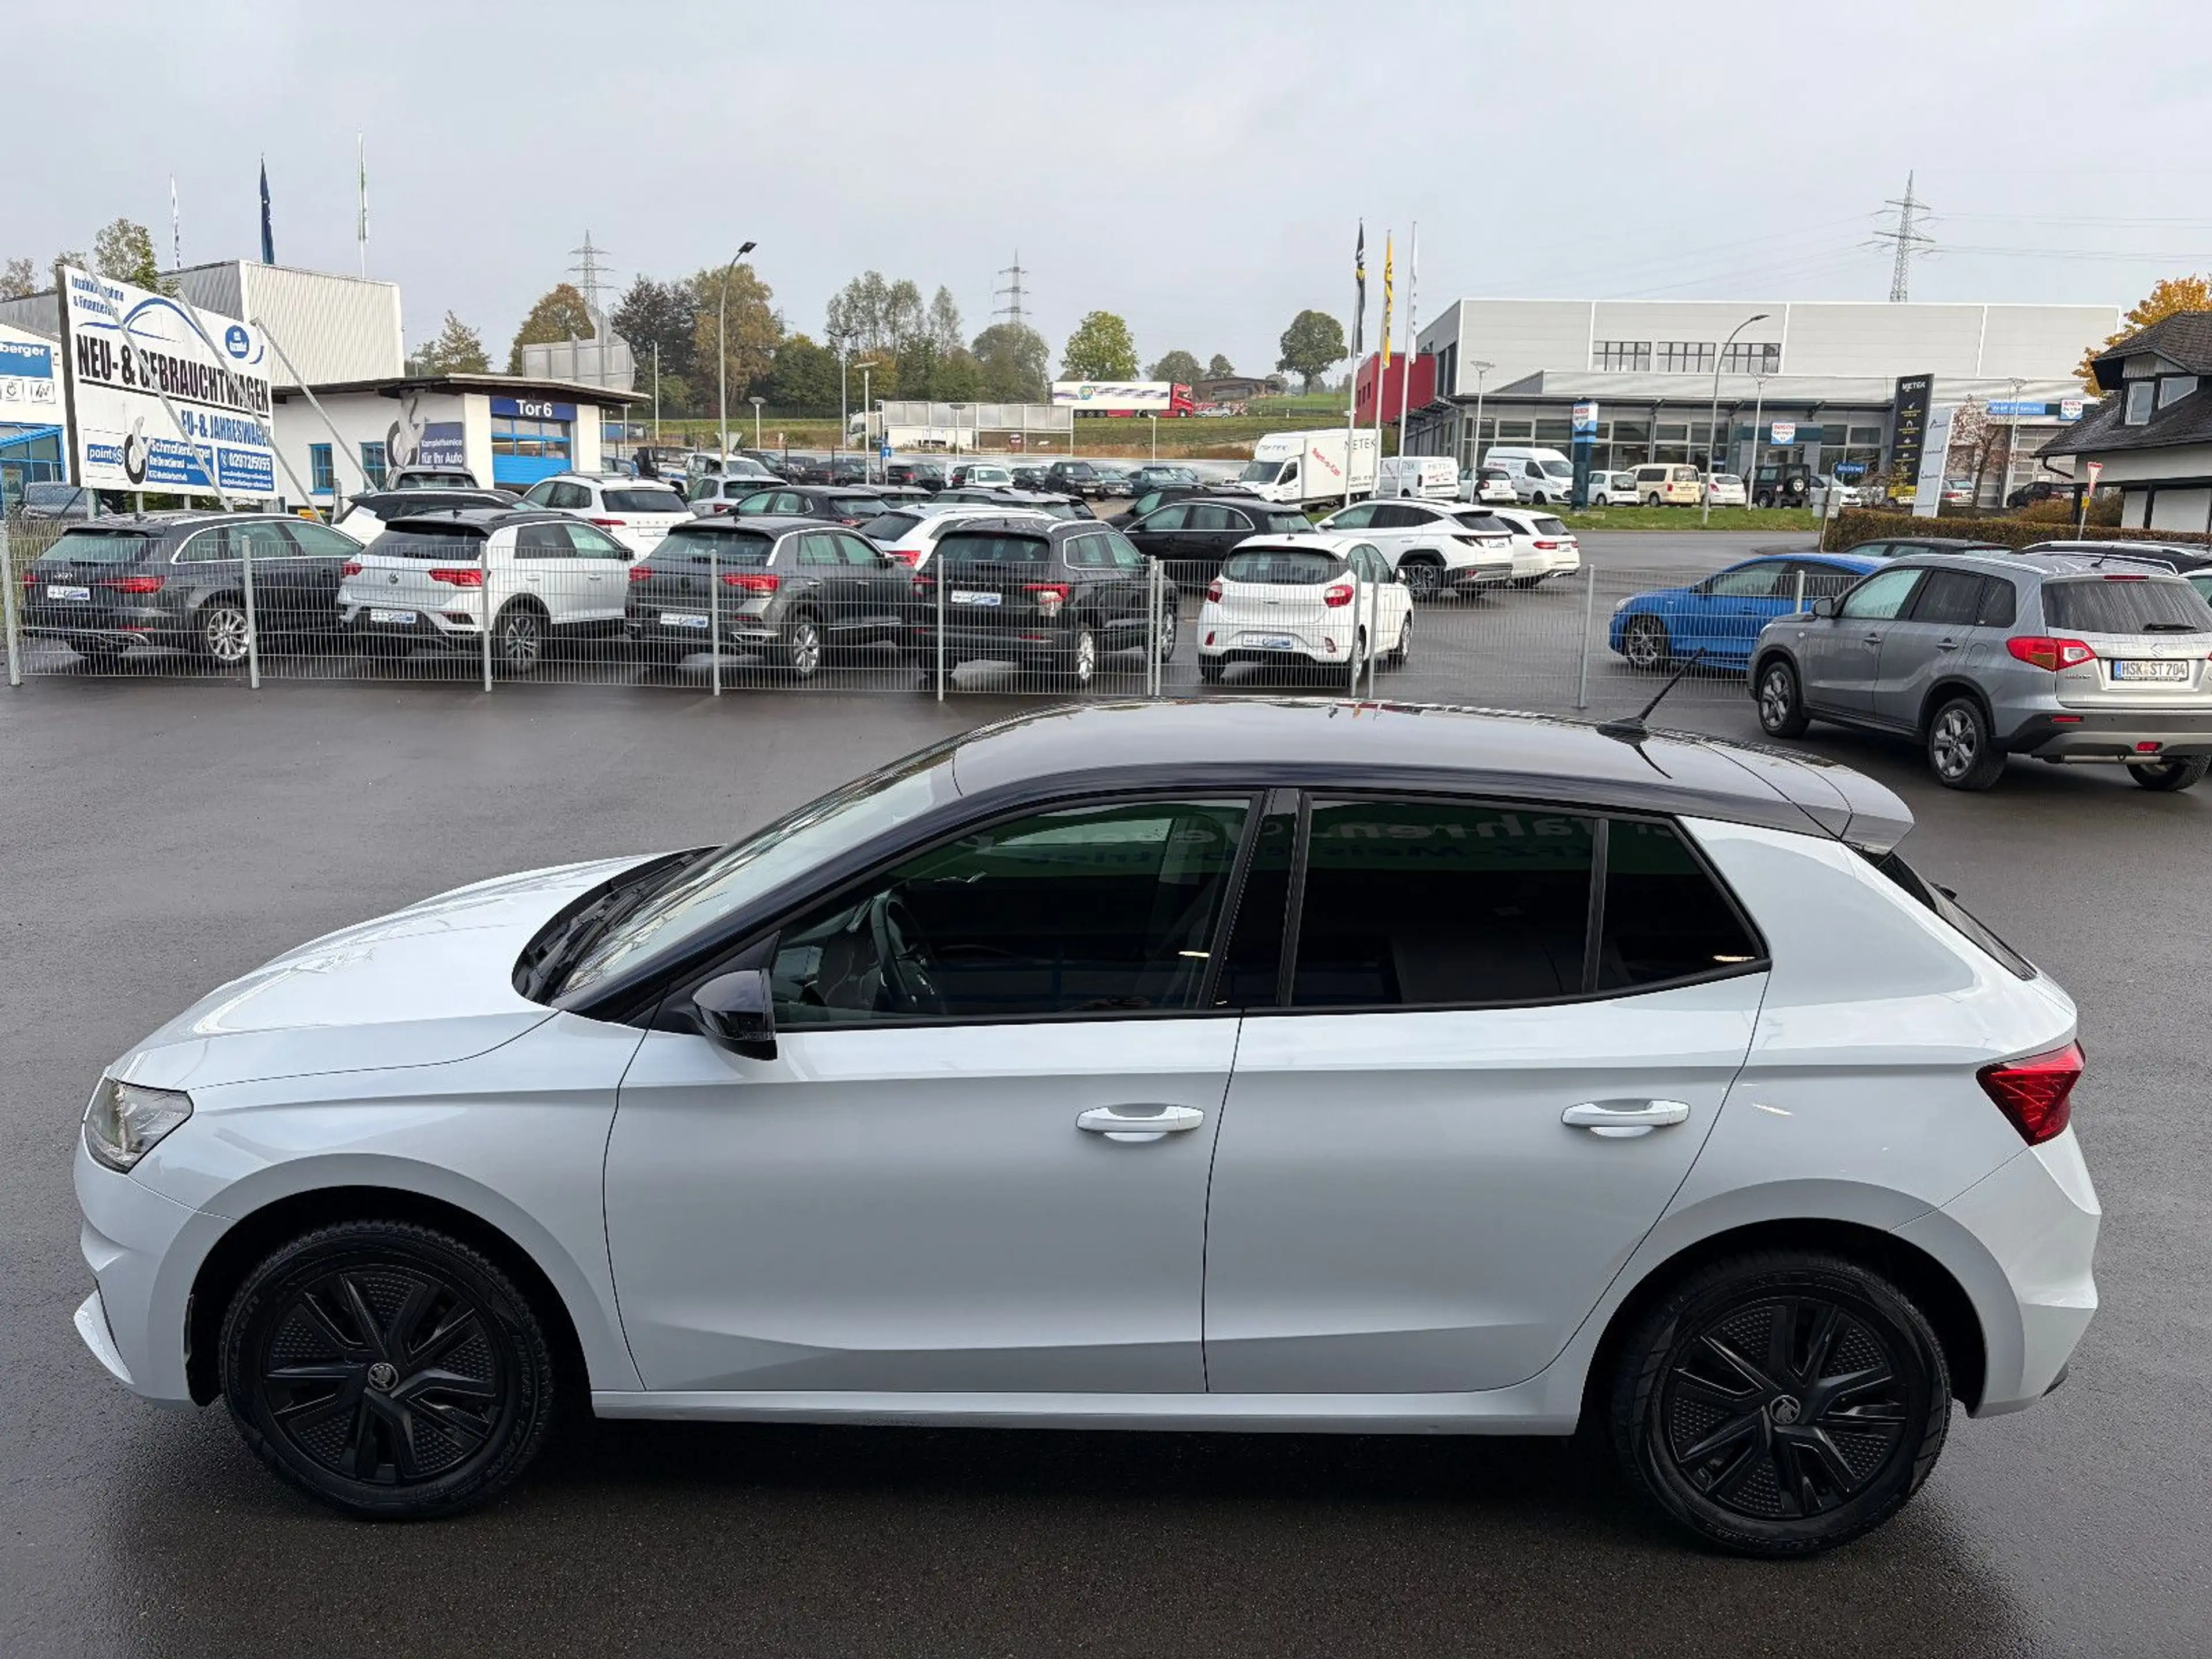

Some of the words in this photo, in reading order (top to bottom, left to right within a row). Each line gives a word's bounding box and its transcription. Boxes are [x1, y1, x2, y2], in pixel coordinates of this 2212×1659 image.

[76, 334, 118, 381] NEU-
[121, 344, 136, 385] &
[139, 349, 270, 412] GEBRAUCHTWAGEN
[516, 399, 541, 416] Tor
[543, 402, 552, 417] 6
[199, 414, 208, 438] &
[445, 452, 463, 464] Auto
[2122, 662, 2143, 675] HSK
[2150, 662, 2164, 676] ST
[2166, 663, 2186, 676] 704
